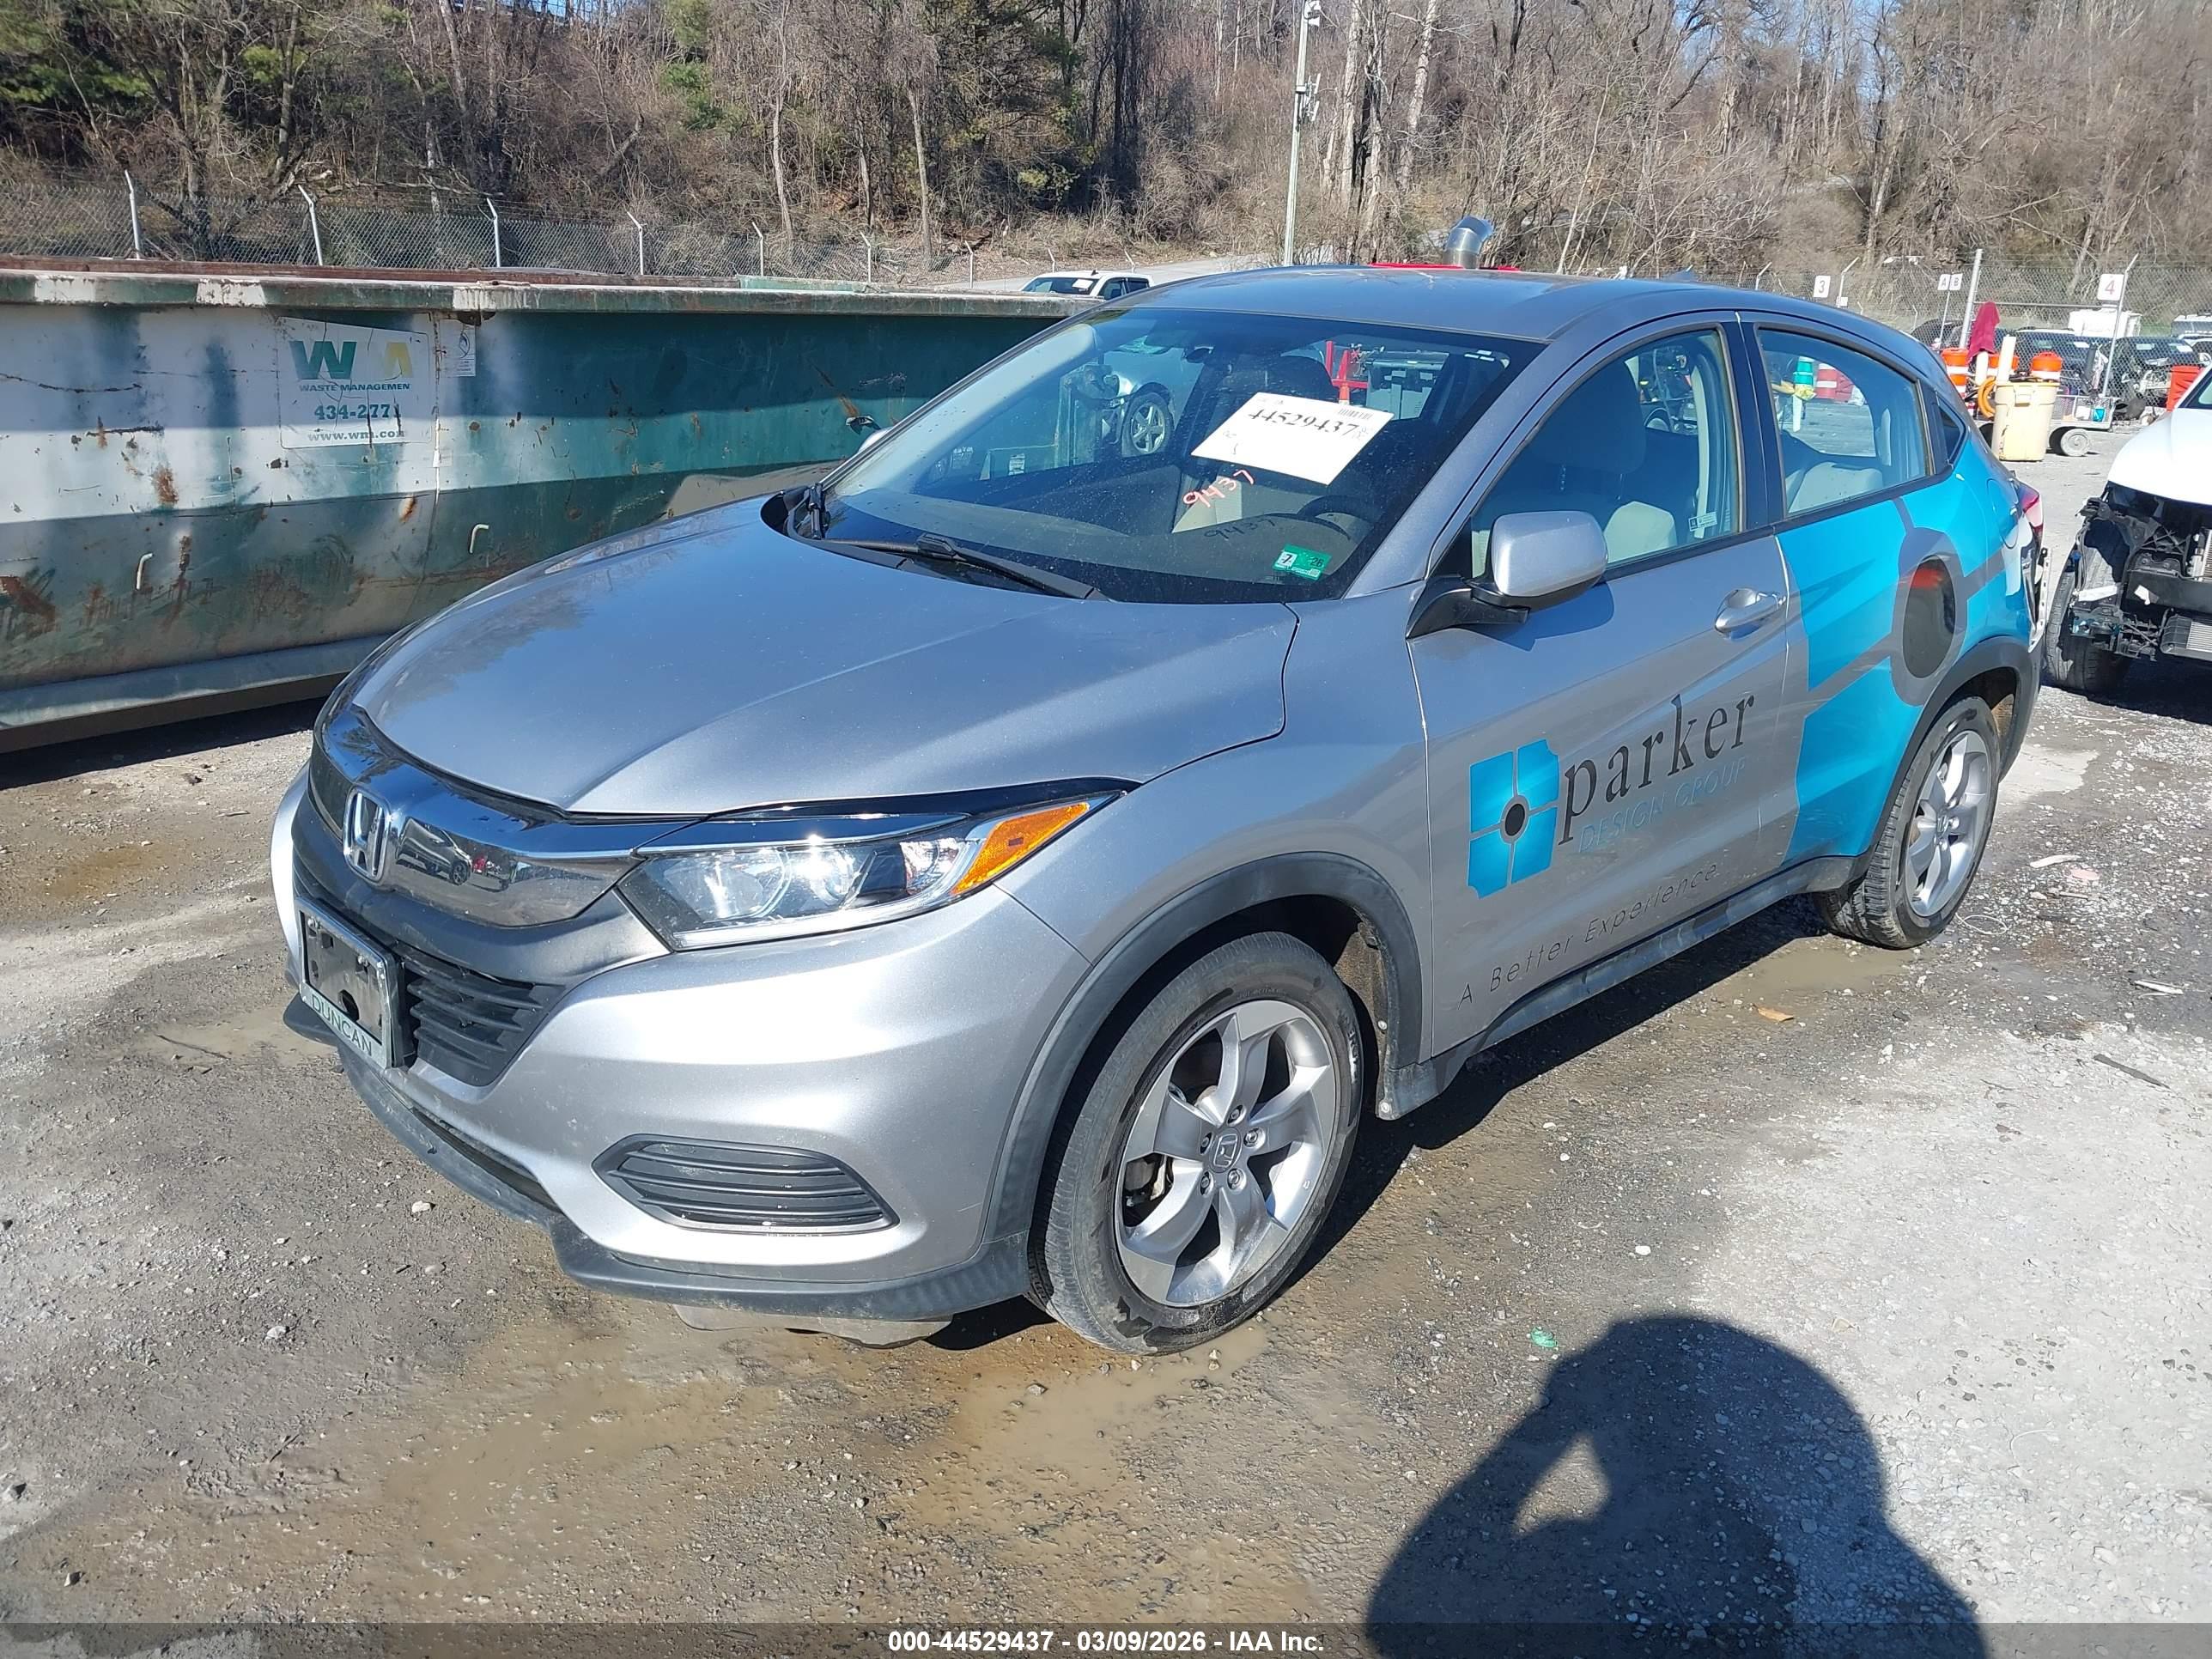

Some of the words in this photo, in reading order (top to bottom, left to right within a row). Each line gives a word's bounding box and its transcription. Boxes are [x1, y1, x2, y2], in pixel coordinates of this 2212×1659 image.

[1818, 280, 1826, 294] 3
[1941, 276, 1947, 288] A
[2105, 280, 2115, 295] 4
[1249, 409, 1359, 435] 44529437
[1183, 470, 1255, 507] 9437
[1283, 554, 1293, 564] 7
[1558, 694, 1754, 846] parker
[1579, 791, 1665, 853] DESIGN
[1675, 757, 1746, 806] GROUP
[1458, 982, 1473, 1011] A
[1490, 934, 1574, 993] Better
[1584, 863, 1717, 942] Experience
[312, 994, 372, 1057] DUNCAN
